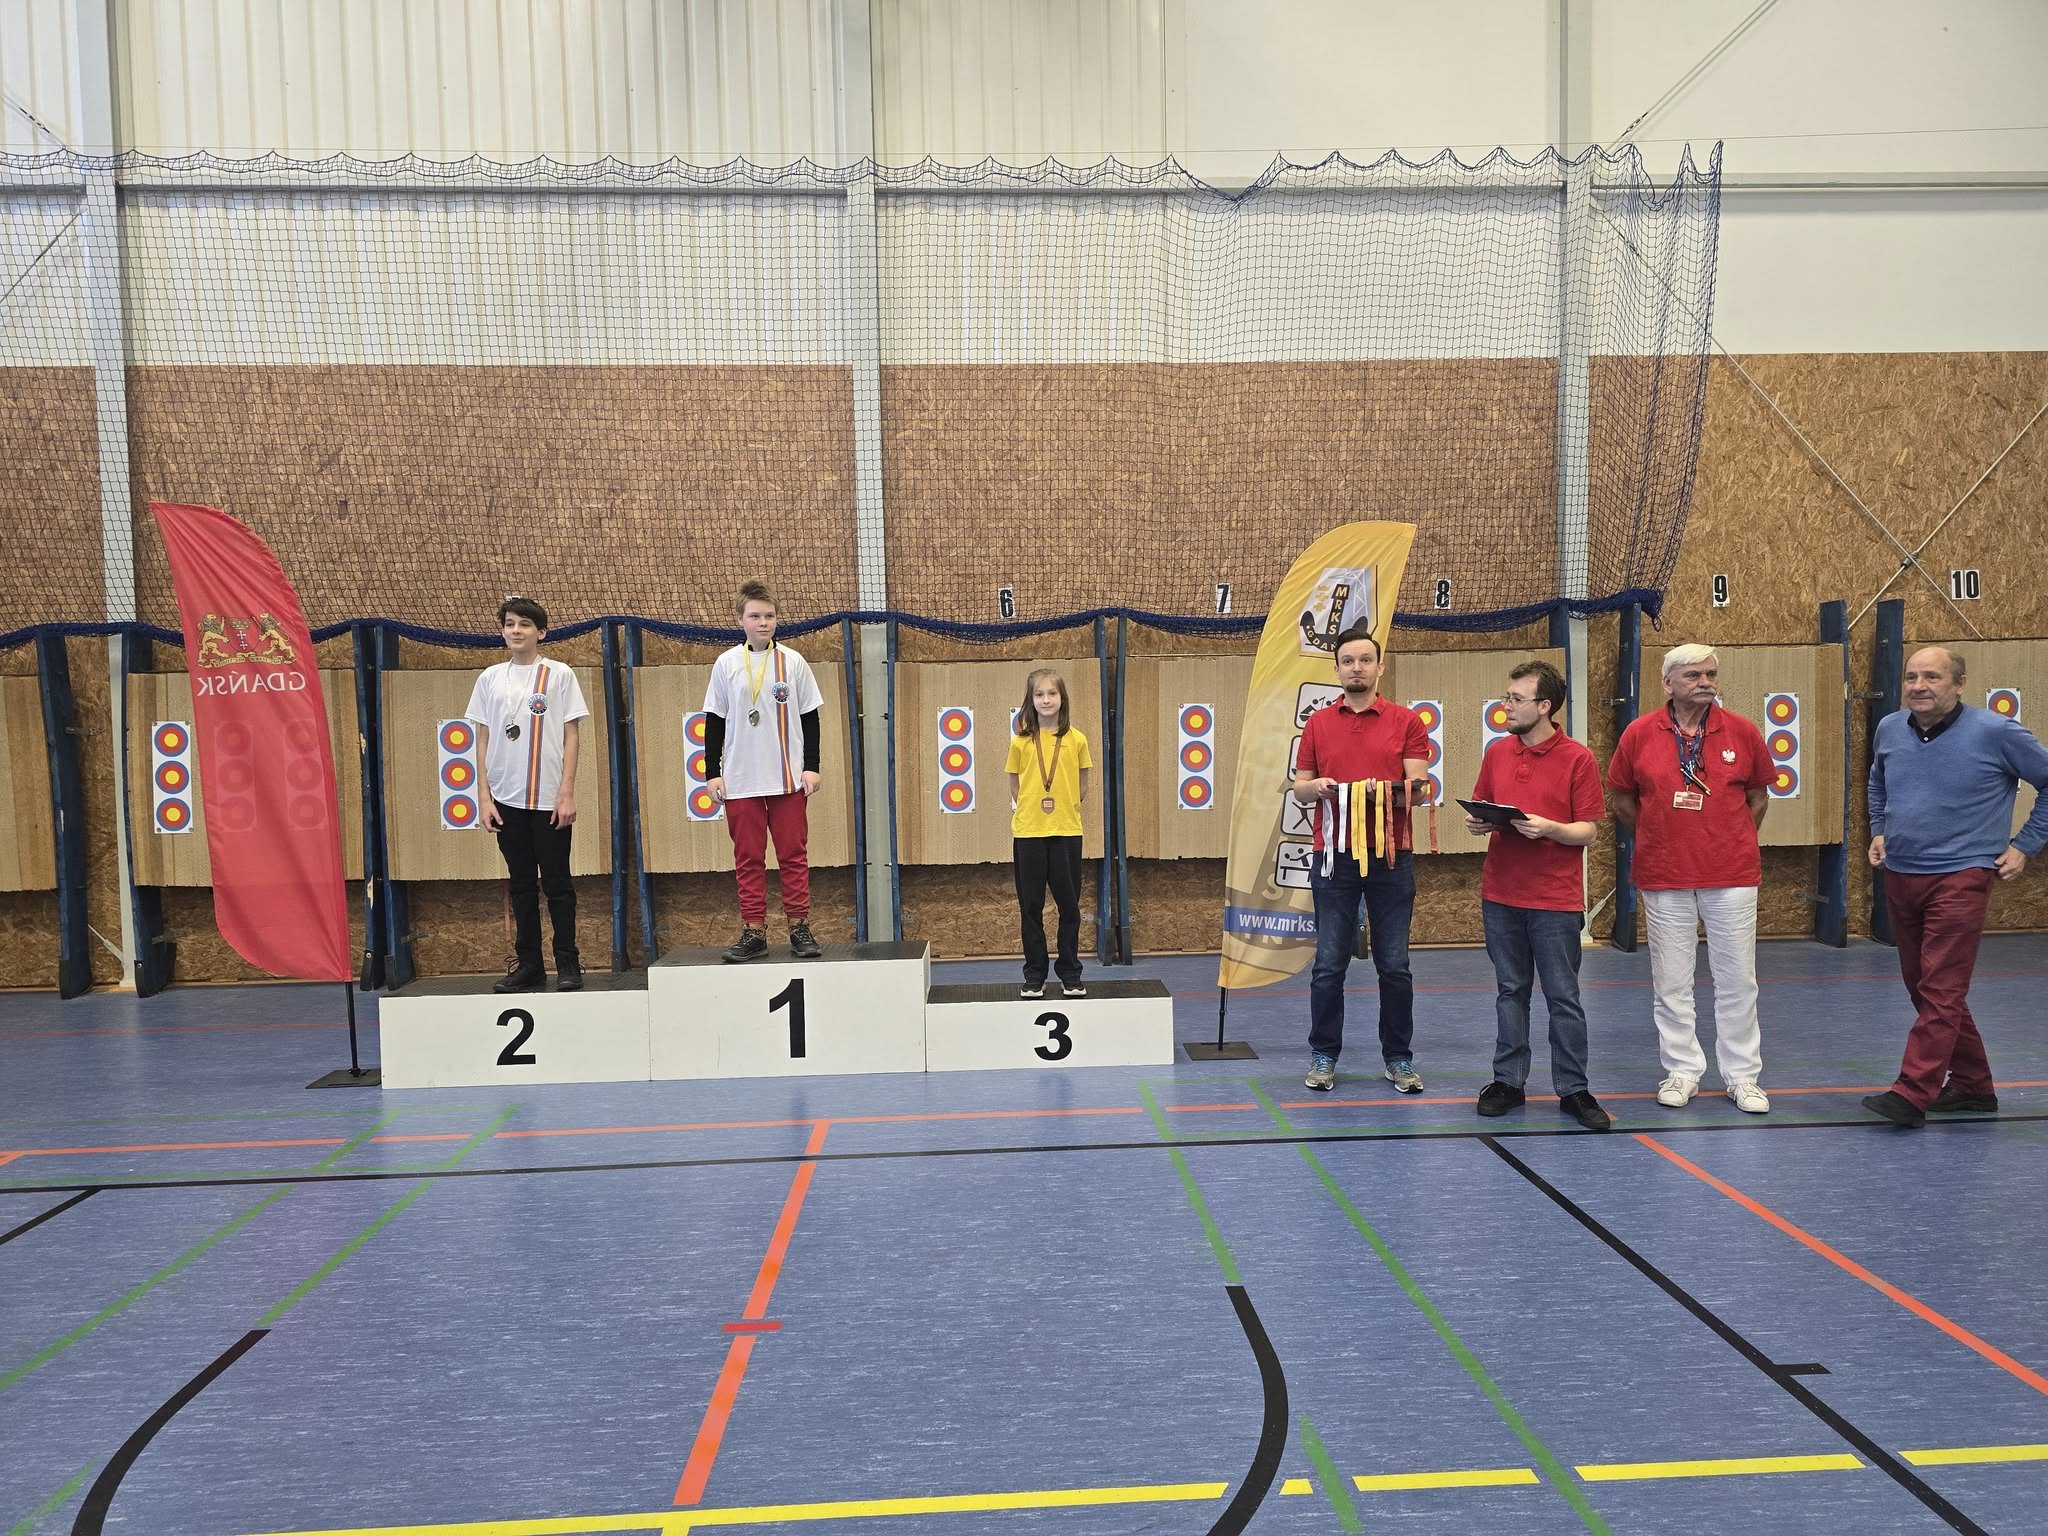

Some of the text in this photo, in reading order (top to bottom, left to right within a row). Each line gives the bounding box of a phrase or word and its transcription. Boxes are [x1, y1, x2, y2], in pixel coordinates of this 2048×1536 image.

[1217, 584, 1230, 613] 7
[1436, 580, 1450, 608] 8
[1713, 575, 1728, 602] 9
[1952, 570, 1980, 599] 10
[1000, 588, 1014, 618] 6
[1328, 586, 1348, 635] MRKS
[1307, 630, 1338, 651] GDAŃ
[1239, 915, 1317, 932] www.mrks.
[769, 978, 806, 1059] 1
[496, 1008, 537, 1065] 2
[1034, 1012, 1073, 1061] 3
